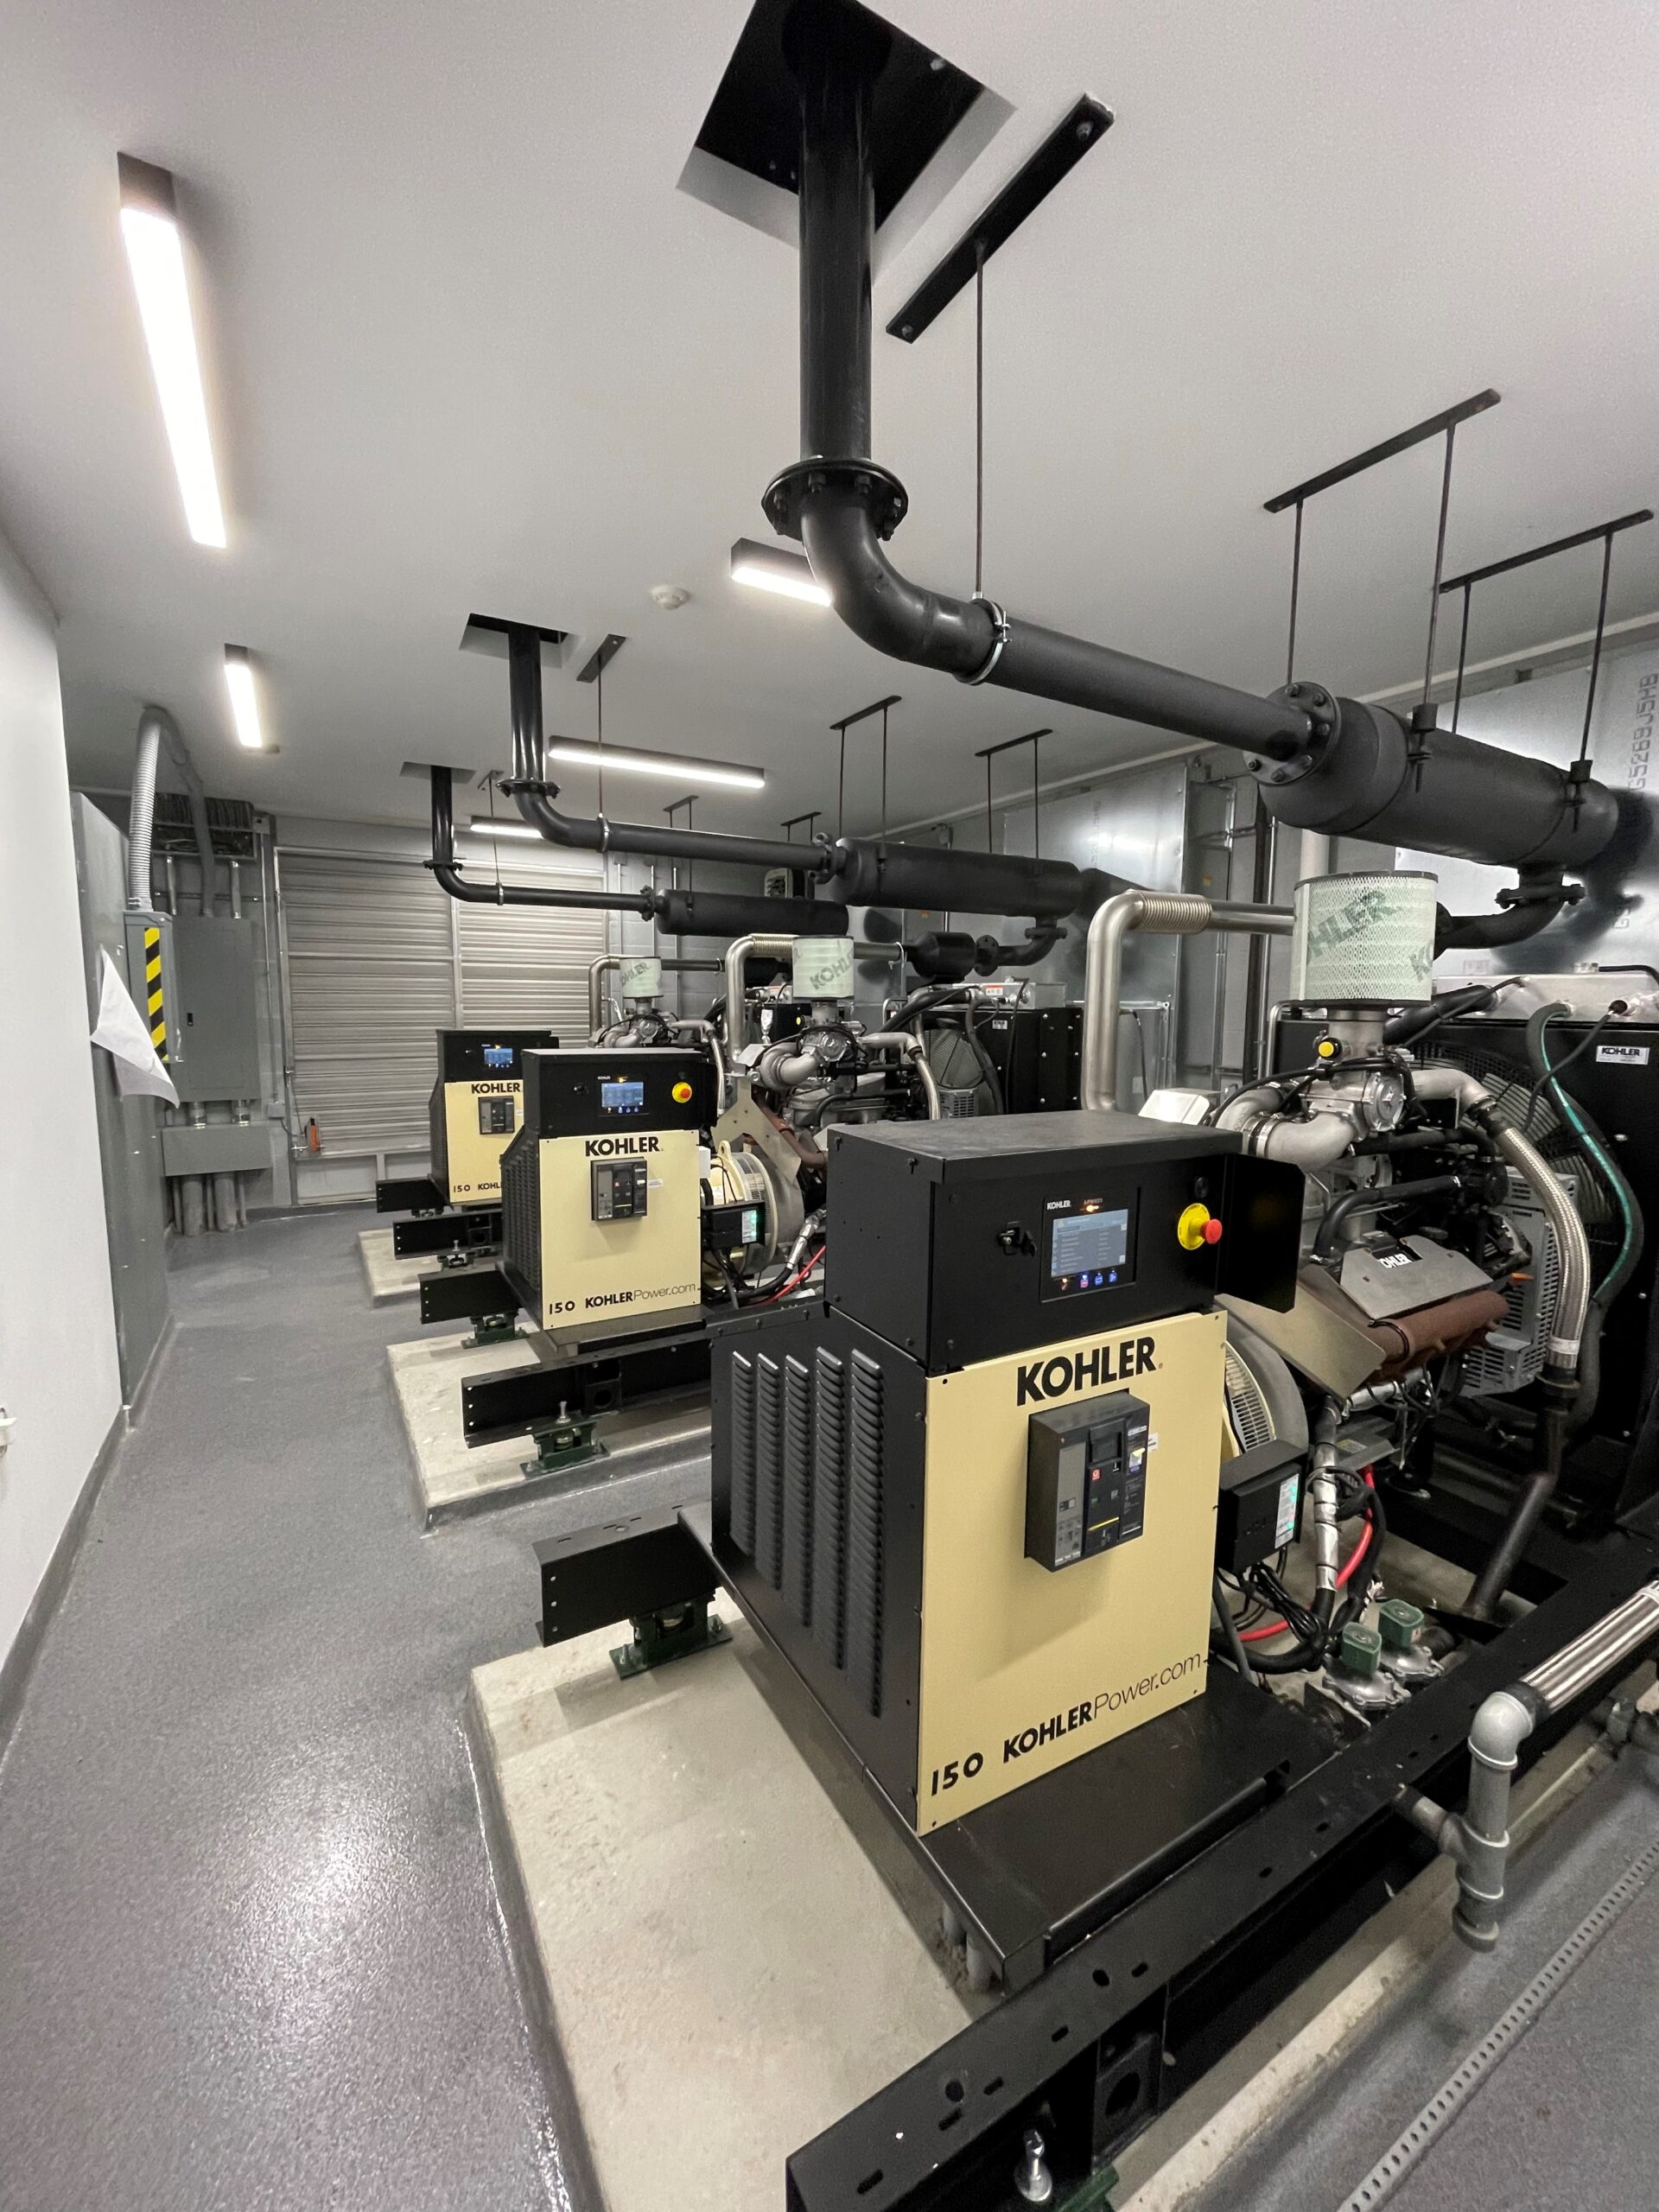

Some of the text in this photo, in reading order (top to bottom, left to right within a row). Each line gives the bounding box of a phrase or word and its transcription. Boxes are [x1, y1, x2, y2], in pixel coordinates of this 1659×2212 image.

[1306, 890, 1400, 966] HLER
[620, 961, 650, 987] OHLER
[1601, 1047, 1640, 1056] KOHLER
[471, 1083, 521, 1094] KOHLER
[585, 1136, 660, 1156] KOHLER
[453, 1181, 502, 1193] 150 KOHL
[1046, 1199, 1071, 1210] KOHLER
[1377, 1253, 1413, 1268] OHLER
[549, 1283, 696, 1314] 150 KOHLERPower.com
[1016, 1336, 1157, 1407] KOHLER
[931, 1653, 1201, 1797] 150 KOHLERPower.com
